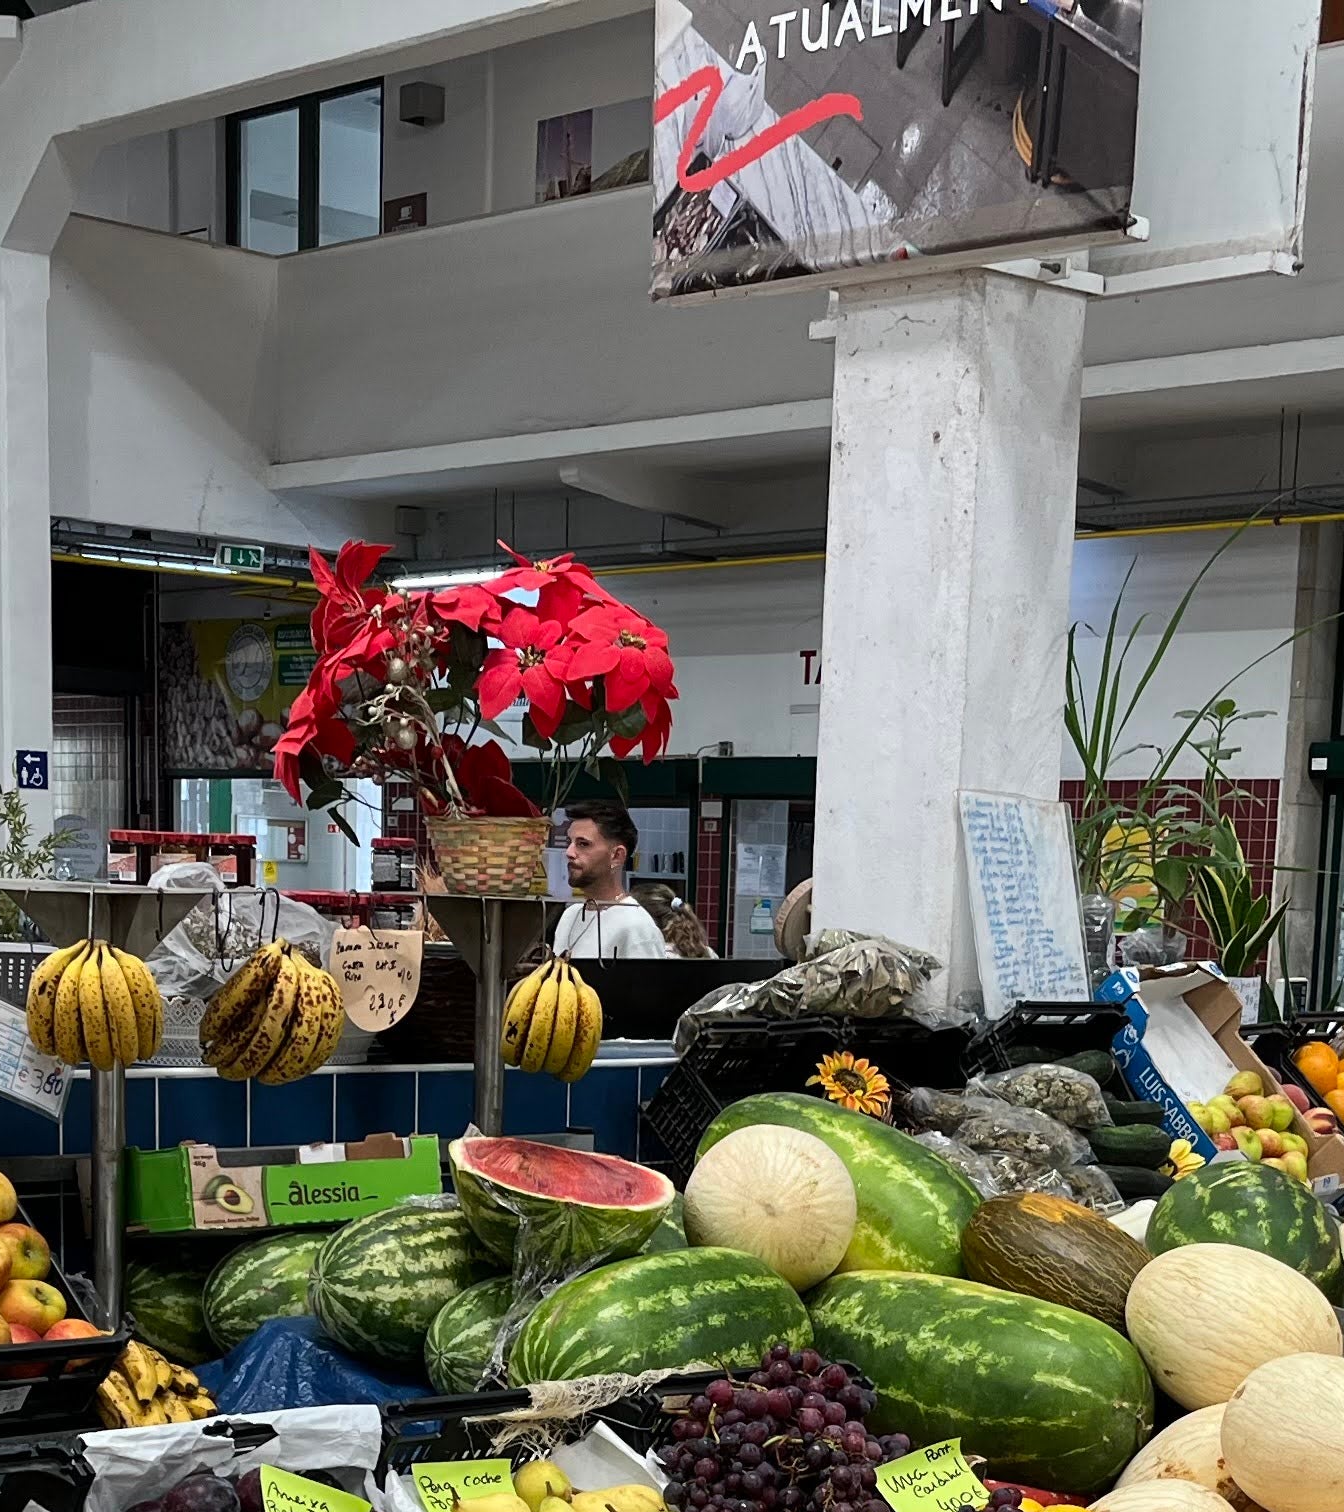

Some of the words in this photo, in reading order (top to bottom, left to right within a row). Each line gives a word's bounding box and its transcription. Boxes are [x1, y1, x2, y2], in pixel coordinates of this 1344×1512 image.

[736, 0, 1004, 70] ATUALME
[1138, 1066, 1168, 1102] LUIS
[1163, 1098, 1200, 1148] SABBO
